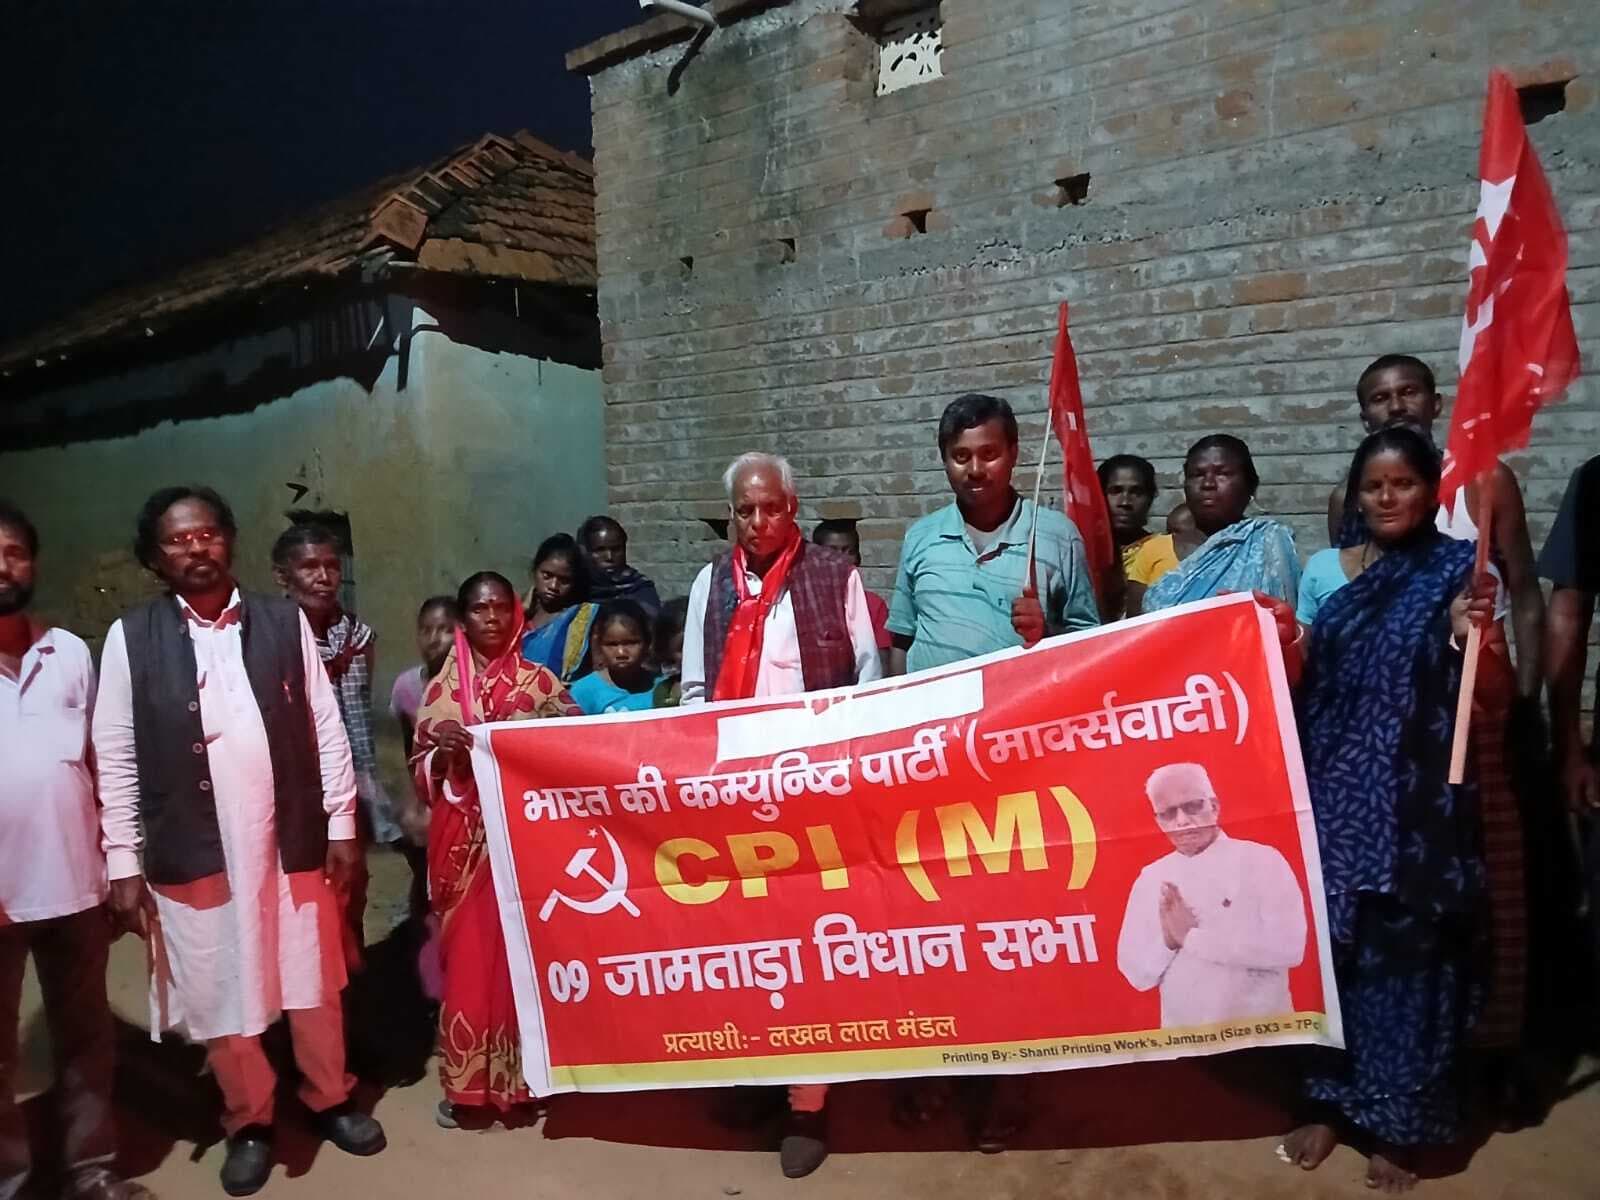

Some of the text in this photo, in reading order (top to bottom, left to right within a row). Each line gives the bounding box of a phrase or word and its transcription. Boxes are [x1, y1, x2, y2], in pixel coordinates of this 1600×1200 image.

[523, 786, 611, 822] भारत
[615, 765, 671, 815] की
[861, 724, 949, 789] पार्टी
[654, 785, 1097, 905] CPI (M)
[598, 938, 805, 1010] जामताड़ा
[812, 912, 968, 982] विधान
[976, 913, 1100, 972] सभा
[767, 1022, 833, 1048] लखन
[837, 1018, 892, 1044] लाल
[895, 1010, 959, 1040] मंडल
[942, 1052, 989, 1064] Printing
[1019, 1046, 1058, 1059] Shanti
[1062, 1042, 1112, 1056] Printing
[1165, 1033, 1217, 1046] Jamtara
[1220, 1027, 1252, 1043] (Size
